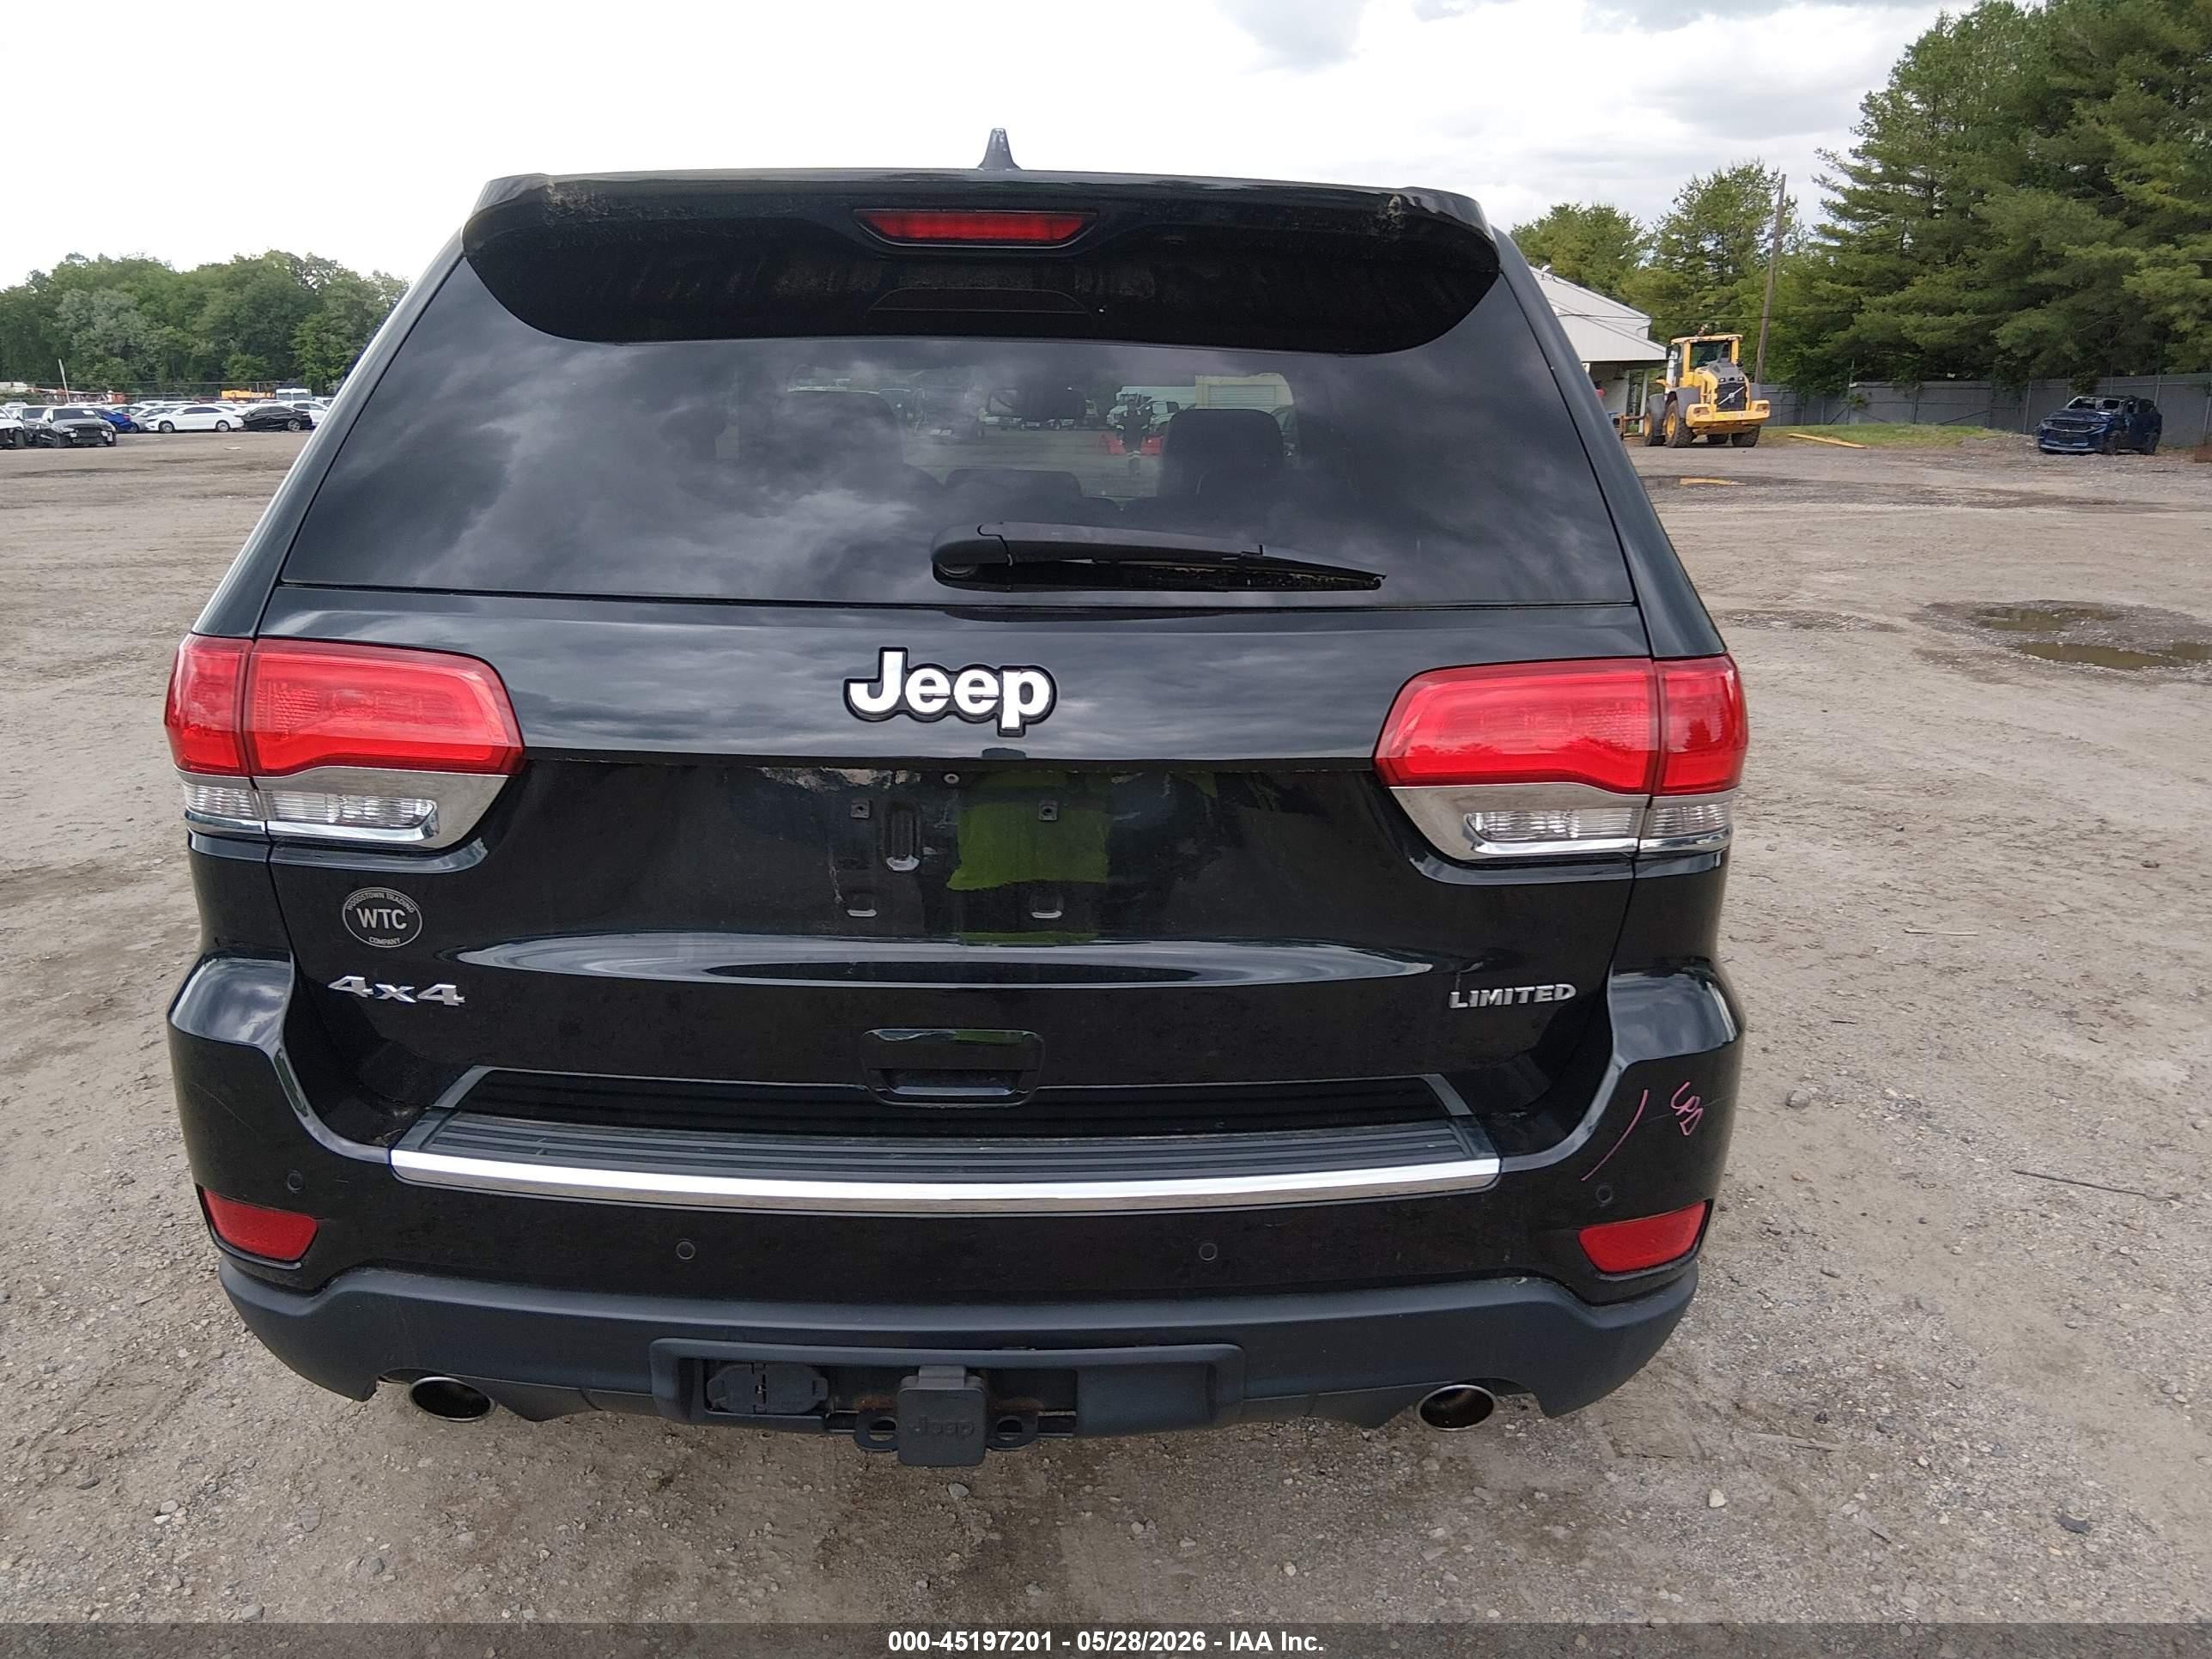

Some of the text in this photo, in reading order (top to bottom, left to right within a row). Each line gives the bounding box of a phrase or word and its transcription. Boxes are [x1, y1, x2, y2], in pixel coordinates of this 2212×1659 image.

[847, 648, 1054, 732] Jeep
[386, 892, 415, 914] TRADING
[356, 907, 408, 930] WTC
[368, 936, 401, 945] COMPANY
[1449, 983, 1577, 1009] LIMITED
[907, 1414, 975, 1440] Jeep
